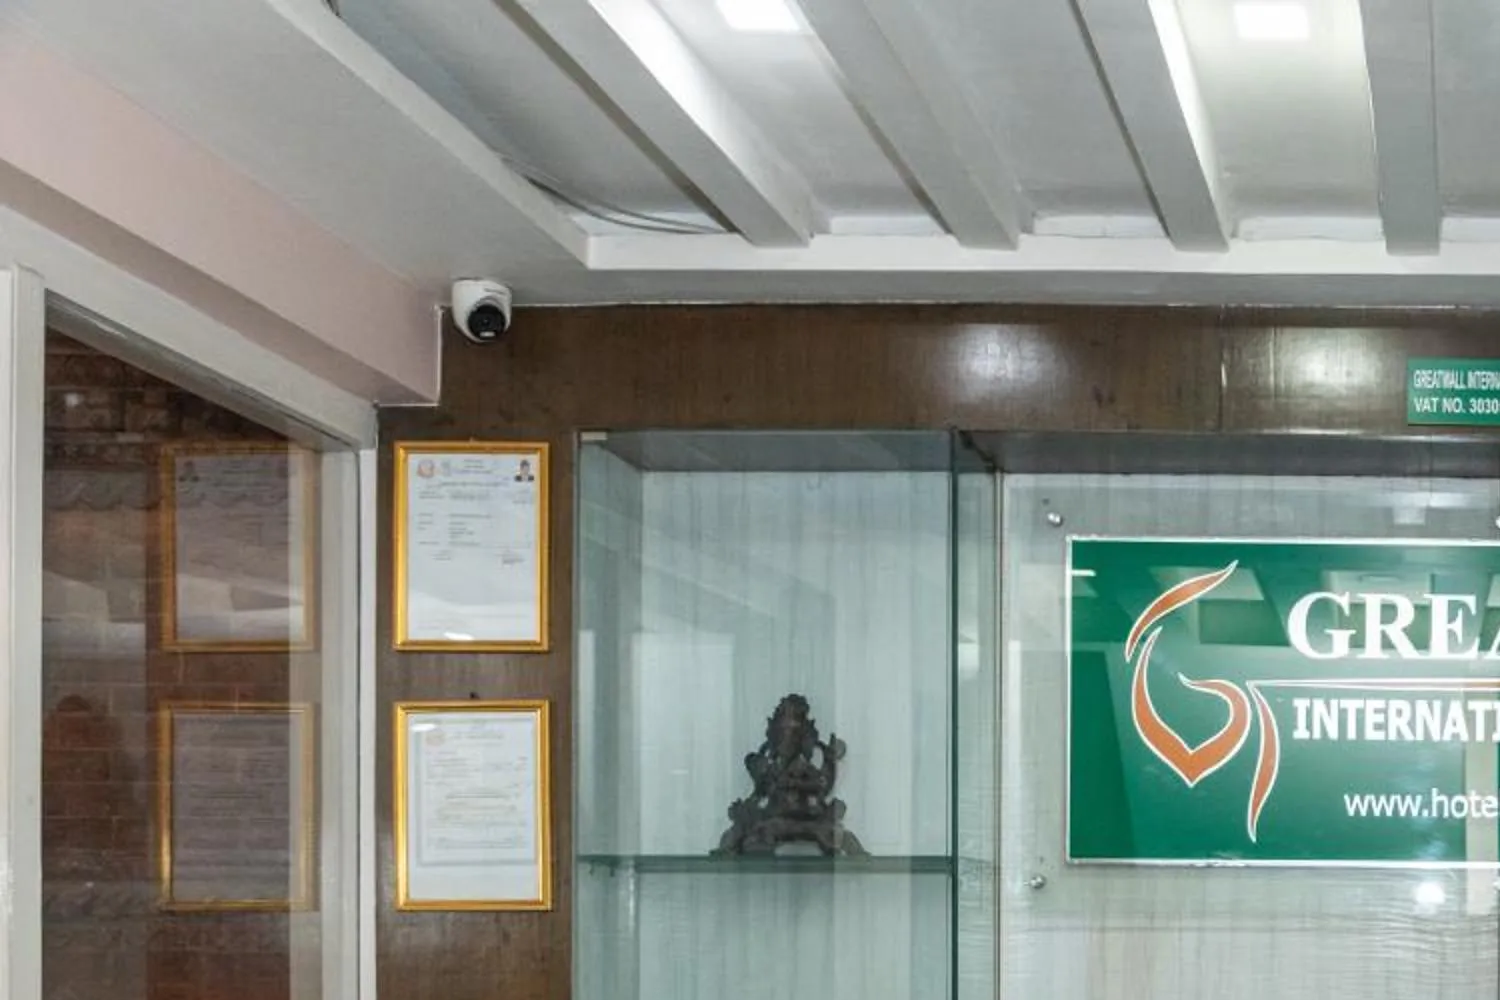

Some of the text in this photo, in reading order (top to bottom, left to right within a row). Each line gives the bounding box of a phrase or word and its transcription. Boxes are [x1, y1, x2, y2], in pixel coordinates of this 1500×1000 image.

[1413, 368, 1466, 390] GREATWALL
[1413, 397, 1439, 413] VAT
[1441, 398, 1466, 414] NO.
